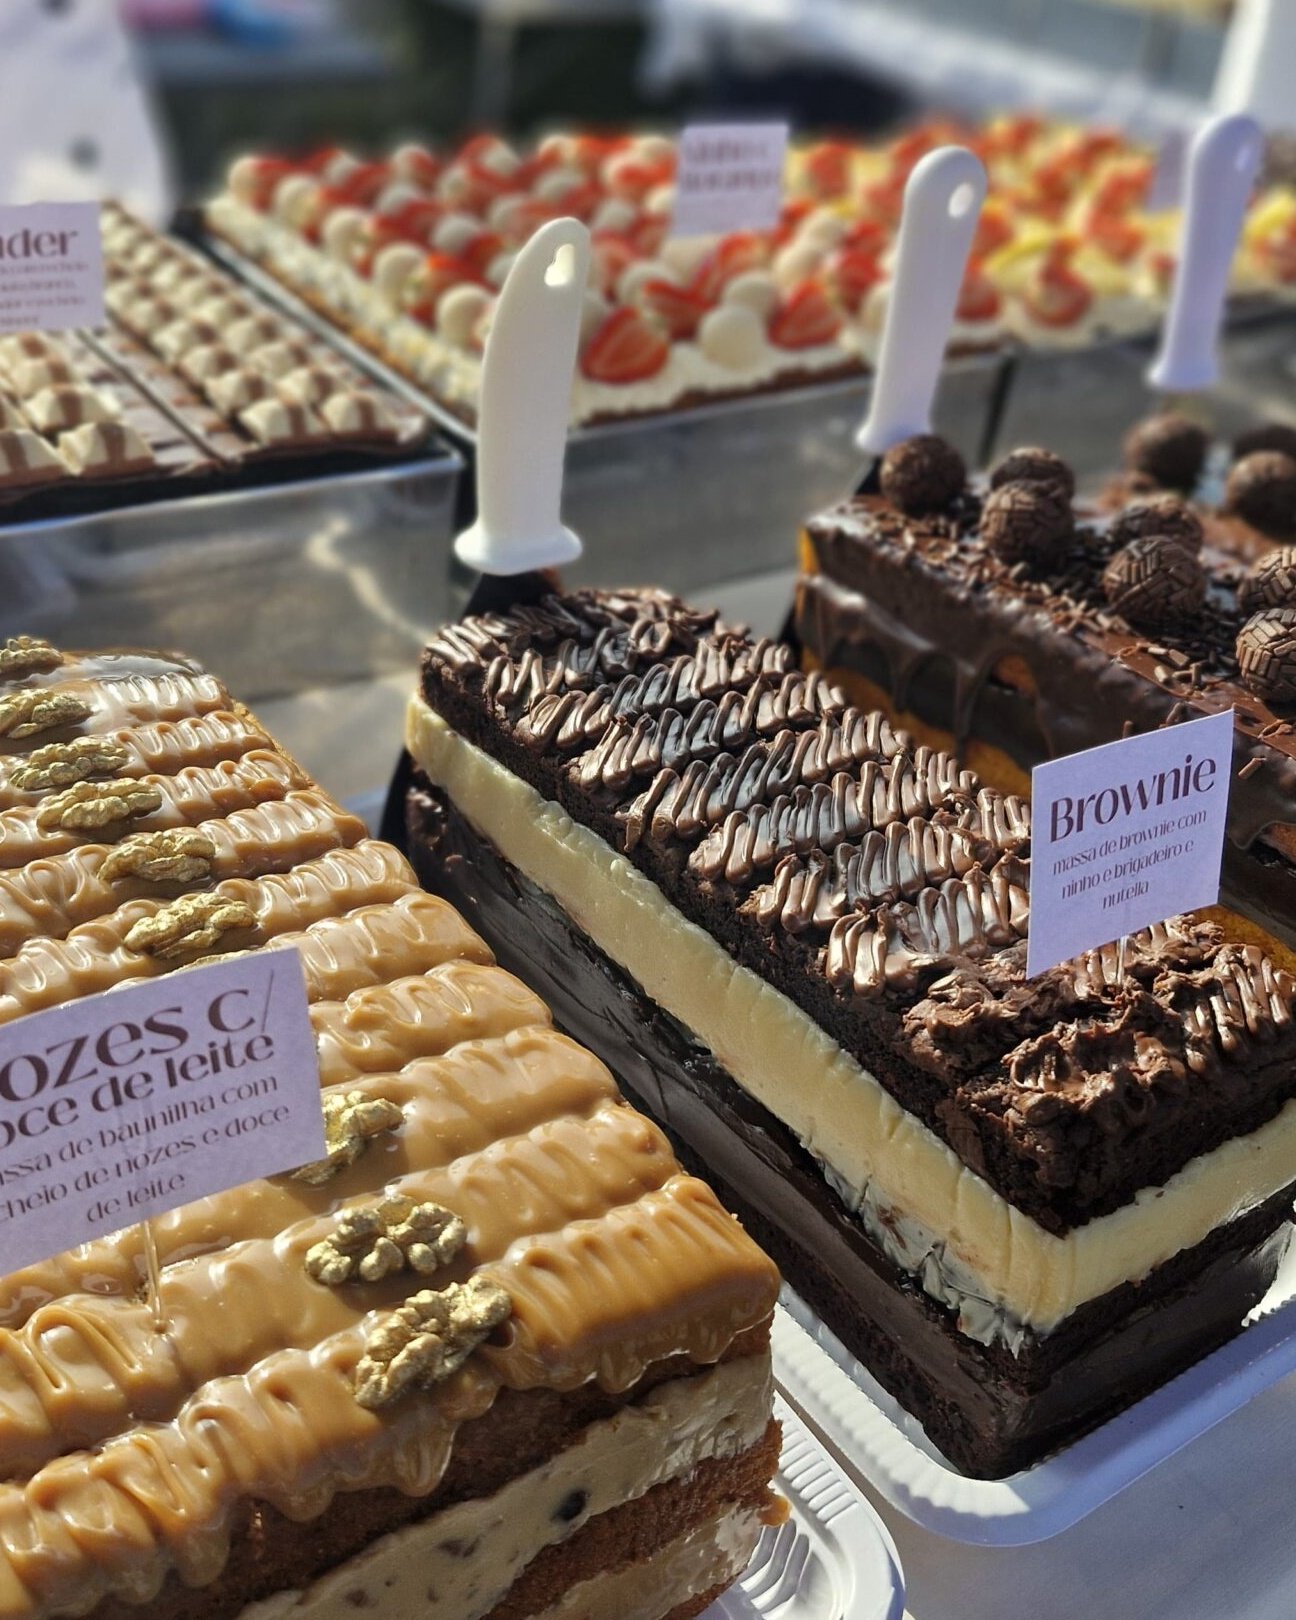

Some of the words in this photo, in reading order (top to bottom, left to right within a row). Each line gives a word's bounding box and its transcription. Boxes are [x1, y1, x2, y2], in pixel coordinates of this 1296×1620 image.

[0, 228, 79, 260] der
[1050, 754, 1217, 843] Brownie
[1053, 847, 1097, 876] massa
[1099, 840, 1117, 857] de
[1119, 820, 1175, 850] brownie
[1177, 810, 1207, 830] com
[1062, 874, 1100, 900] ninho
[1102, 868, 1112, 882] e
[1114, 843, 1182, 879] brigadeiro
[1184, 840, 1194, 853] e
[1102, 880, 1150, 909] nutella
[91, 1071, 153, 1112] de
[164, 1034, 275, 1089] leite
[0, 1153, 52, 1187] ssa
[59, 1138, 94, 1162] de
[98, 1094, 216, 1148] baunilha
[221, 1075, 278, 1105] com
[74, 1167, 109, 1192] de
[115, 1135, 197, 1178] nozes
[202, 1127, 219, 1145] e
[224, 1105, 290, 1138] doce
[86, 1198, 121, 1223] de
[127, 1173, 185, 1208] leite
